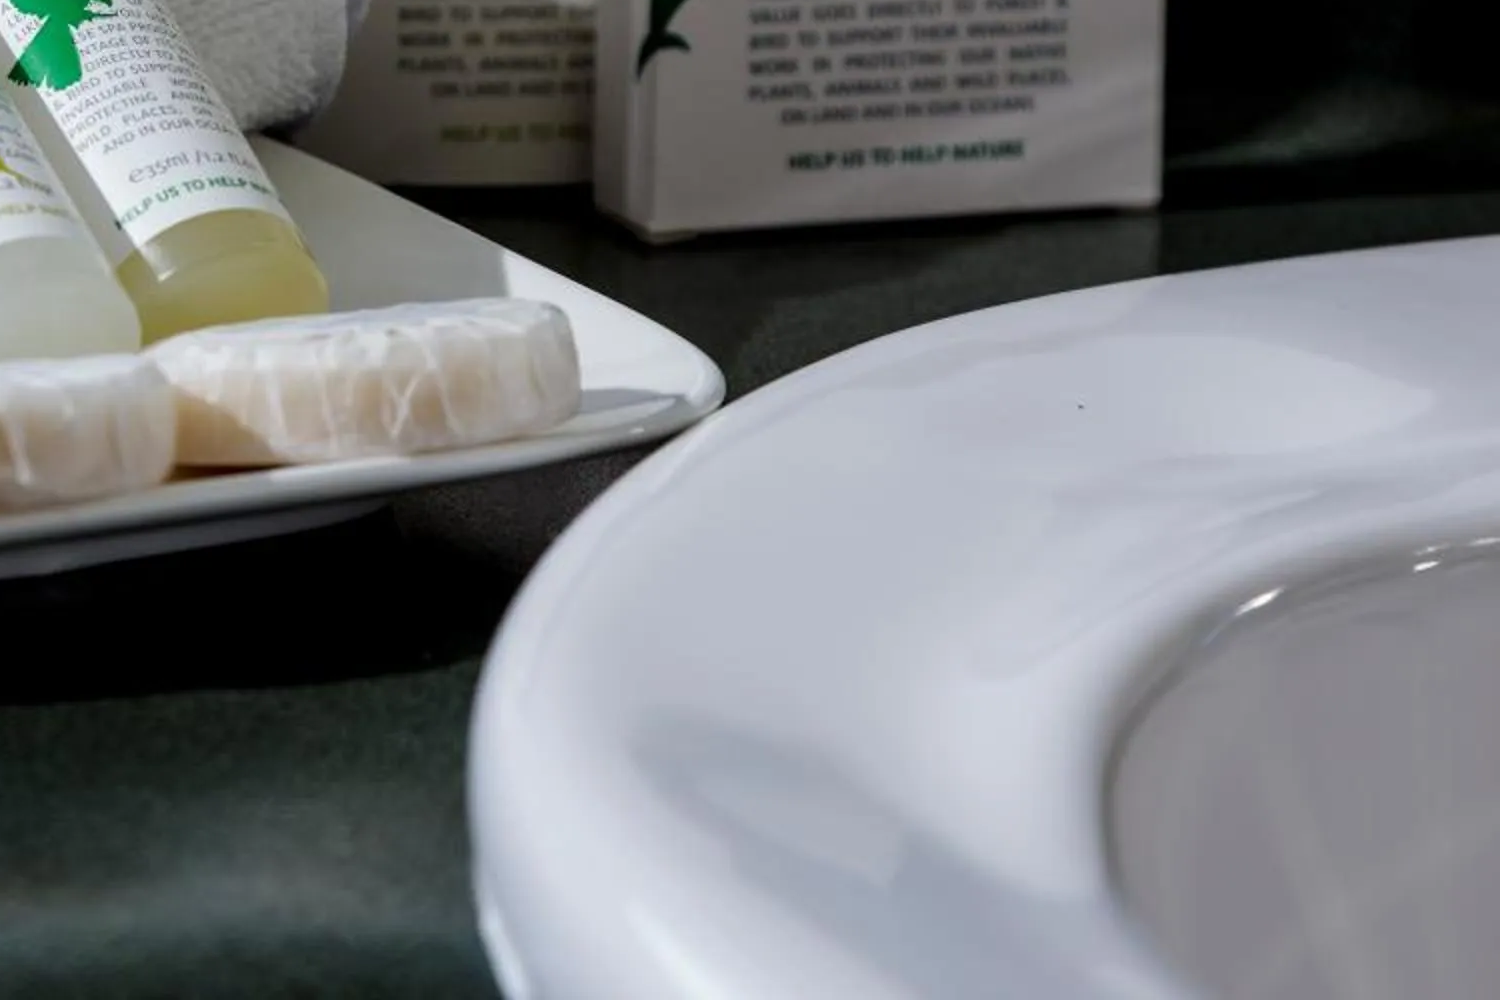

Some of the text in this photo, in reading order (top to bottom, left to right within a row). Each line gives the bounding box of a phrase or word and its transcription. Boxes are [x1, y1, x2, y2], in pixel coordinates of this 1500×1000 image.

[106, 66, 125, 81] TO
[68, 90, 159, 139] PROTECTING
[102, 117, 196, 155] AND IN OUR
[788, 151, 836, 170] HELP
[900, 143, 948, 163] HELP
[952, 139, 1025, 161] NATURE
[114, 175, 249, 231] HELP US TO HELP
